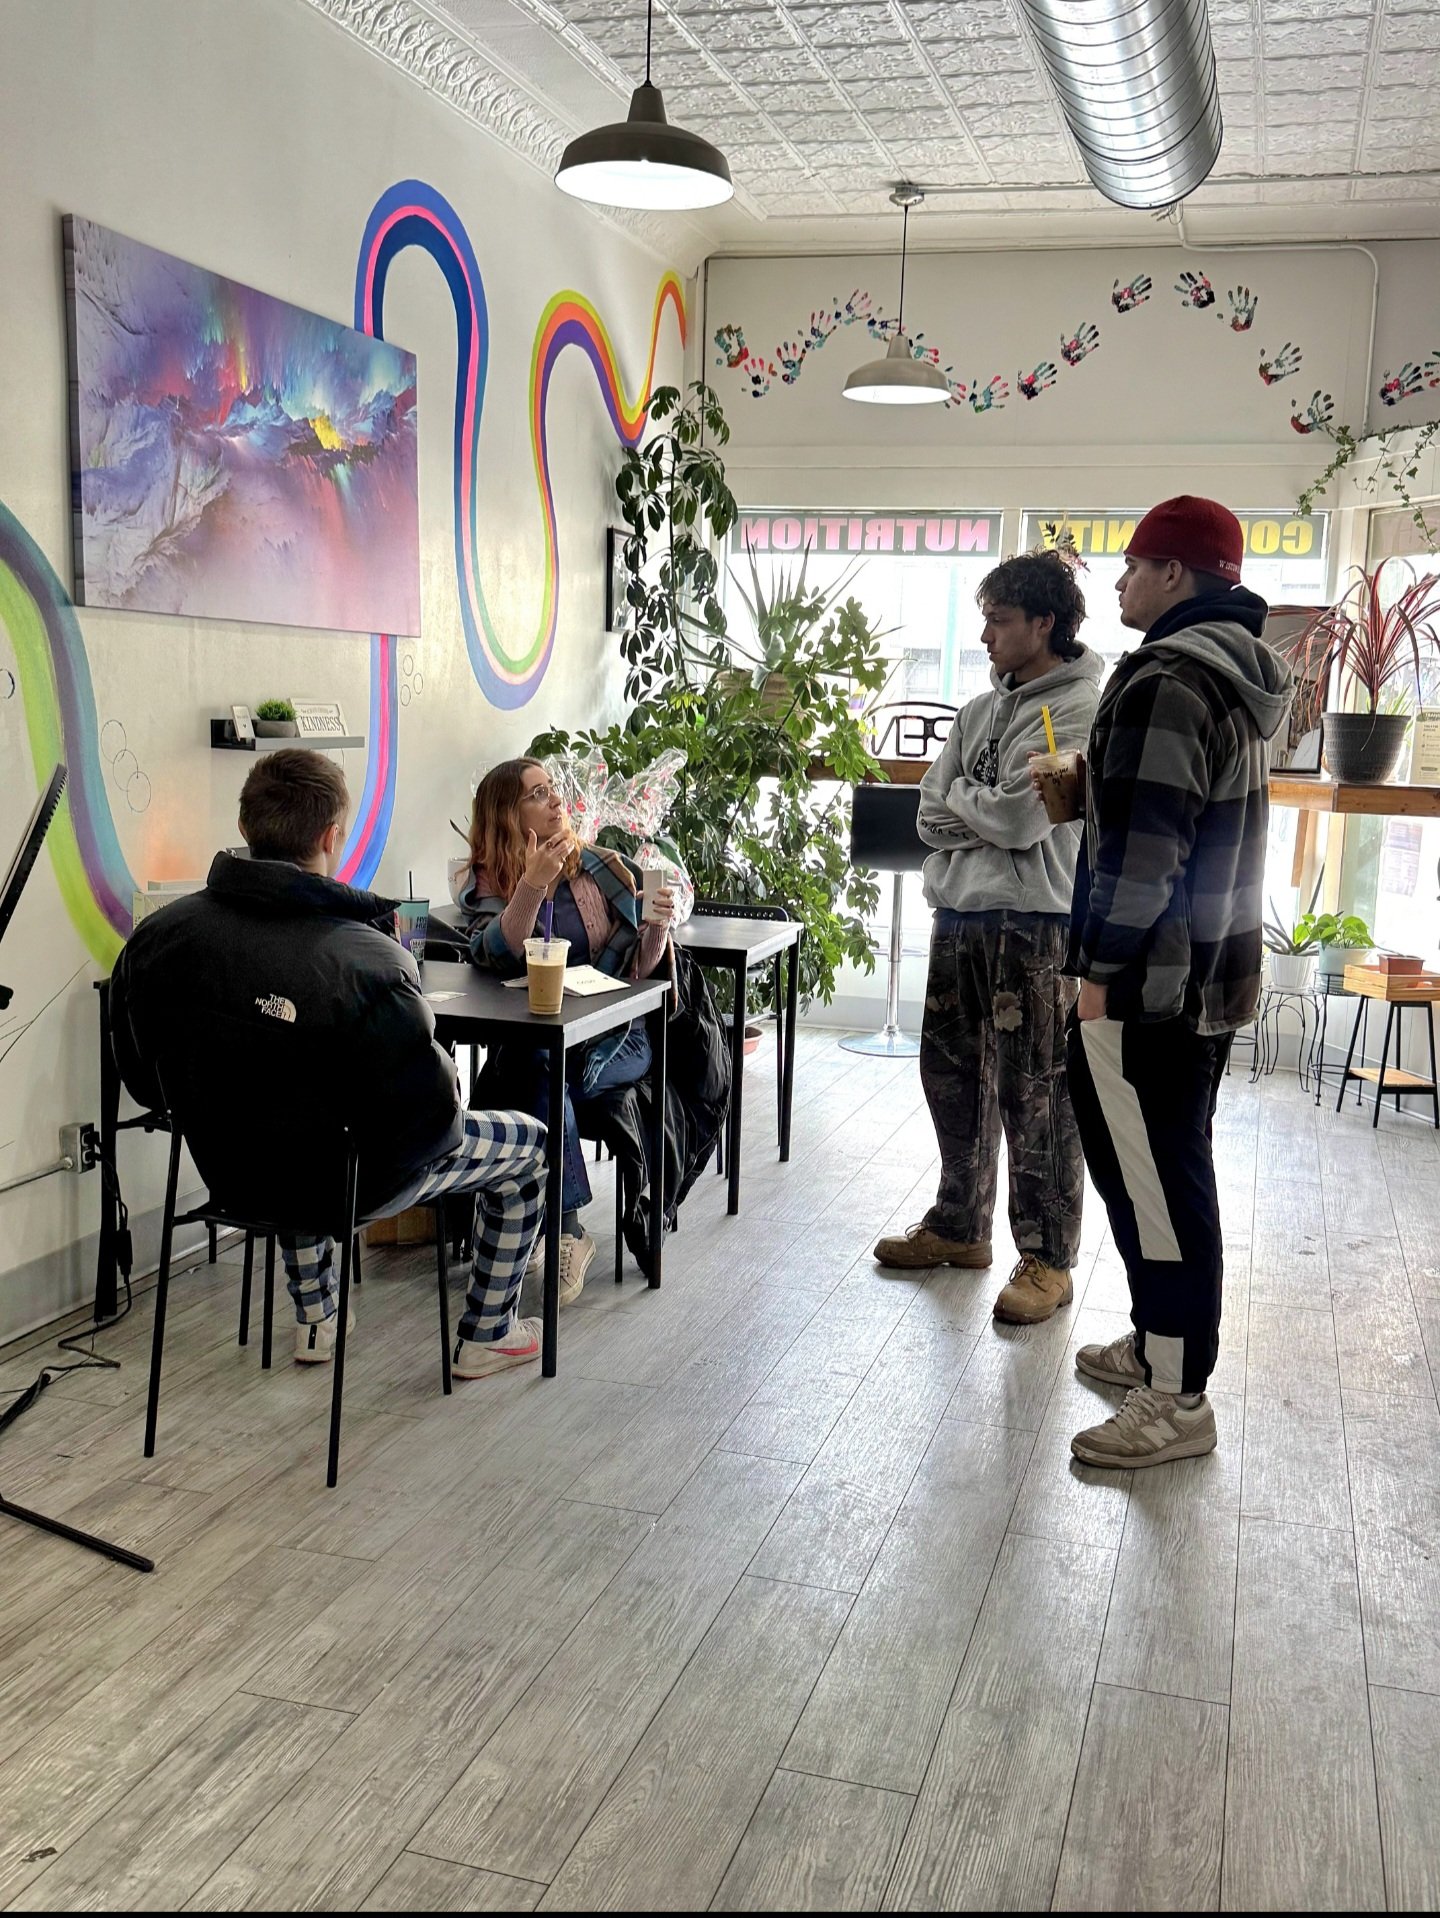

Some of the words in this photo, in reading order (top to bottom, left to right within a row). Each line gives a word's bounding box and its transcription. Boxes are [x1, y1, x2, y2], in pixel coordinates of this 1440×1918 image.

[300, 715, 341, 732] KINDNESS
[254, 997, 284, 1012] NORTH
[269, 993, 286, 1005] THE
[261, 1007, 283, 1018] FACE
[1140, 1417, 1179, 1448] N
